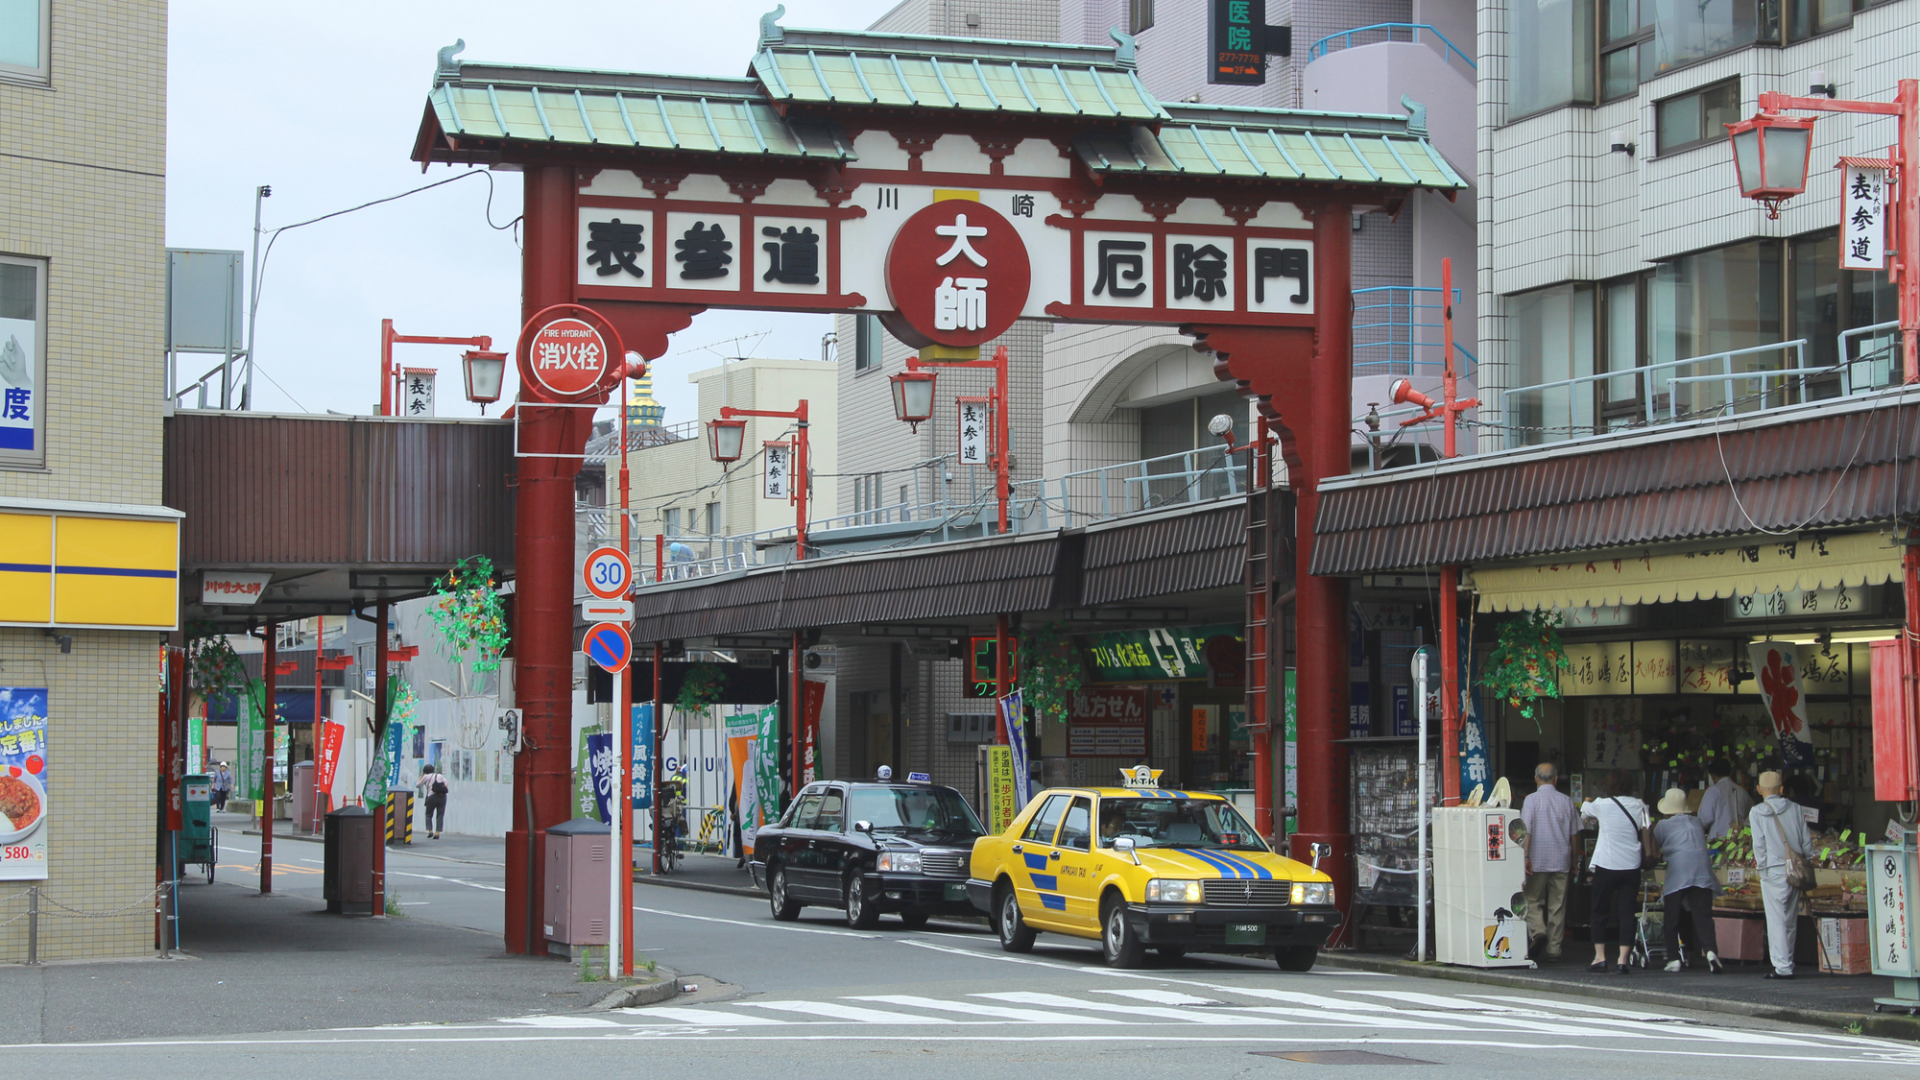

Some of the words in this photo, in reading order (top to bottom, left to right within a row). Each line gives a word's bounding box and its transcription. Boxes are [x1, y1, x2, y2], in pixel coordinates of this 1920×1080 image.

[1229, 1, 1251, 50] 医院
[1219, 53, 1260, 63] 277-7778
[1234, 66, 1245, 74] 2F
[878, 187, 899, 210] 川
[1011, 194, 1035, 218] 崎
[1851, 173, 1874, 262] 表参道
[934, 213, 988, 332] 大師
[1092, 239, 1309, 304] 厄除門
[544, 330, 559, 338] FIRE
[561, 330, 593, 338] HYDRANT
[539, 343, 600, 371] 消火栓
[2, 388, 31, 421] 度
[963, 405, 978, 461] 表参道
[769, 449, 782, 495] 表参道
[205, 581, 262, 596] 川崎大師
[595, 562, 622, 585] 30
[1073, 695, 1142, 718] 処方せん
